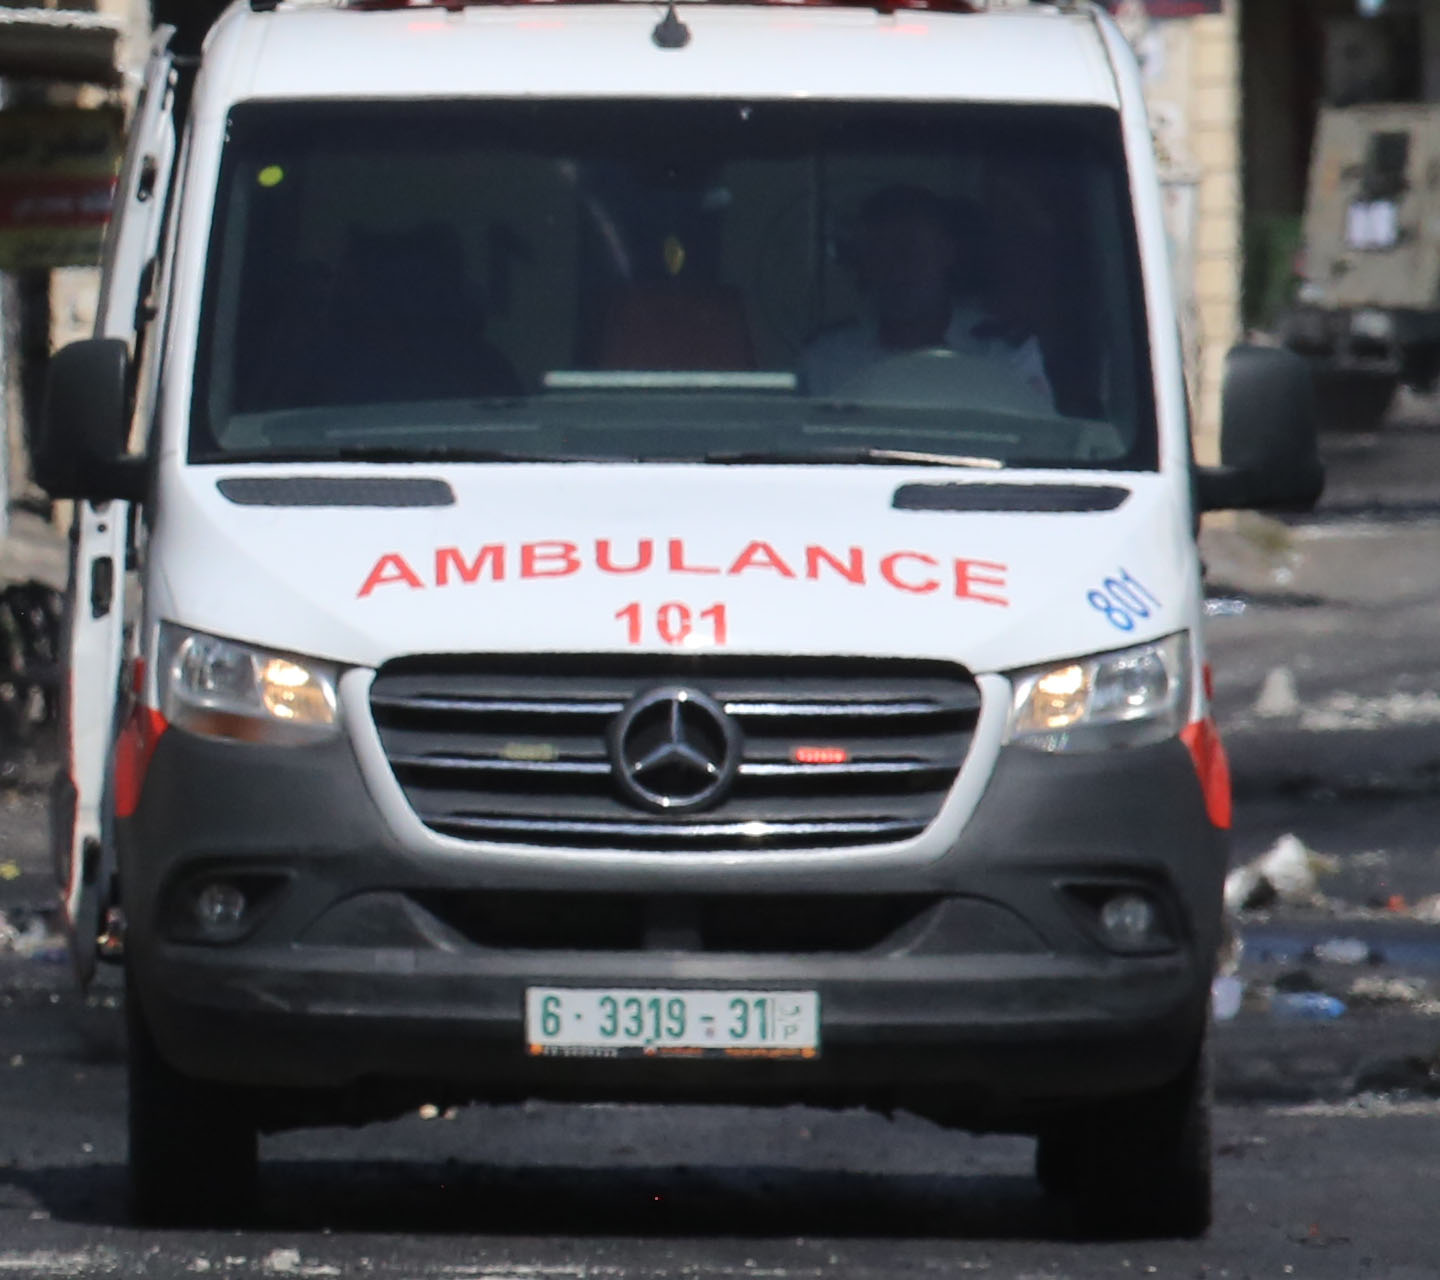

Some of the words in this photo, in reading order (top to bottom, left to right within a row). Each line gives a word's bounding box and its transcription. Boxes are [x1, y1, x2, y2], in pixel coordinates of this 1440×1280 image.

[356, 538, 1011, 608] AMBULANCE
[1086, 565, 1163, 633] 801
[614, 601, 728, 647] 101
